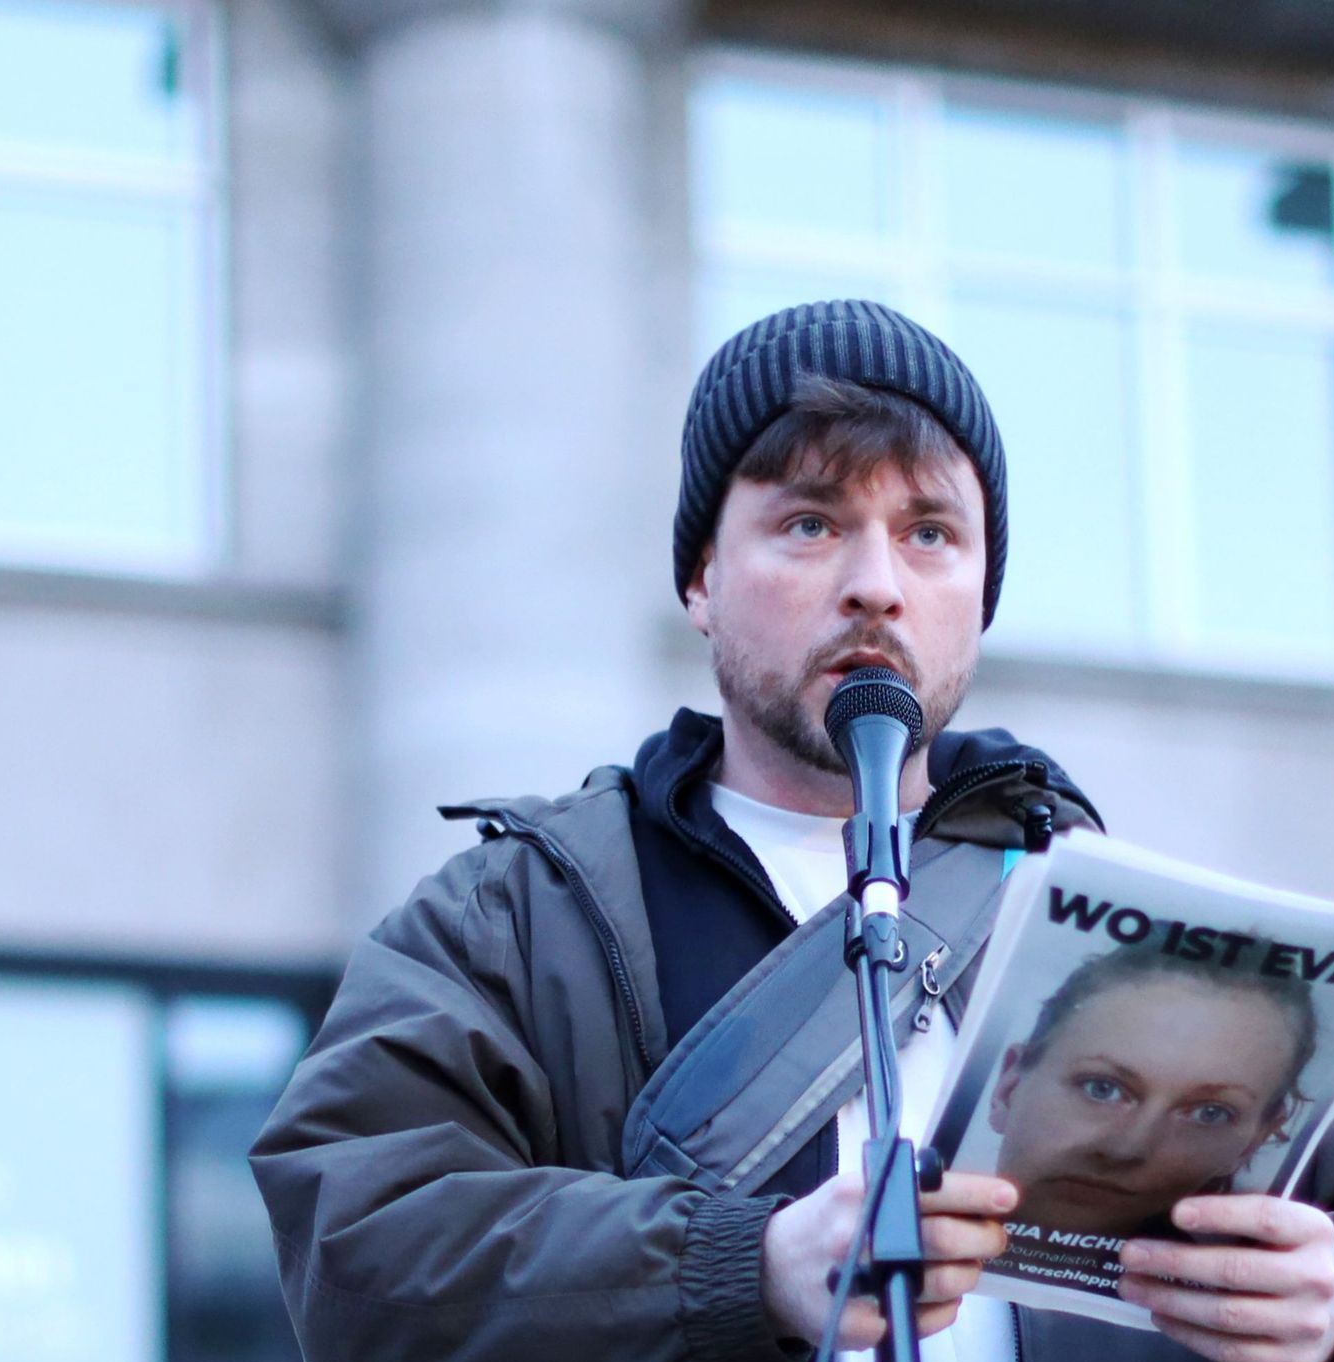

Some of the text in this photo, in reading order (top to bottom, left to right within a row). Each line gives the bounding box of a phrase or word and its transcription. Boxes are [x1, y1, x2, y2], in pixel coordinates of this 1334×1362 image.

[1048, 885, 1152, 945] WO
[1160, 920, 1256, 968] IST
[1018, 1262, 1120, 1290] verschleppt
